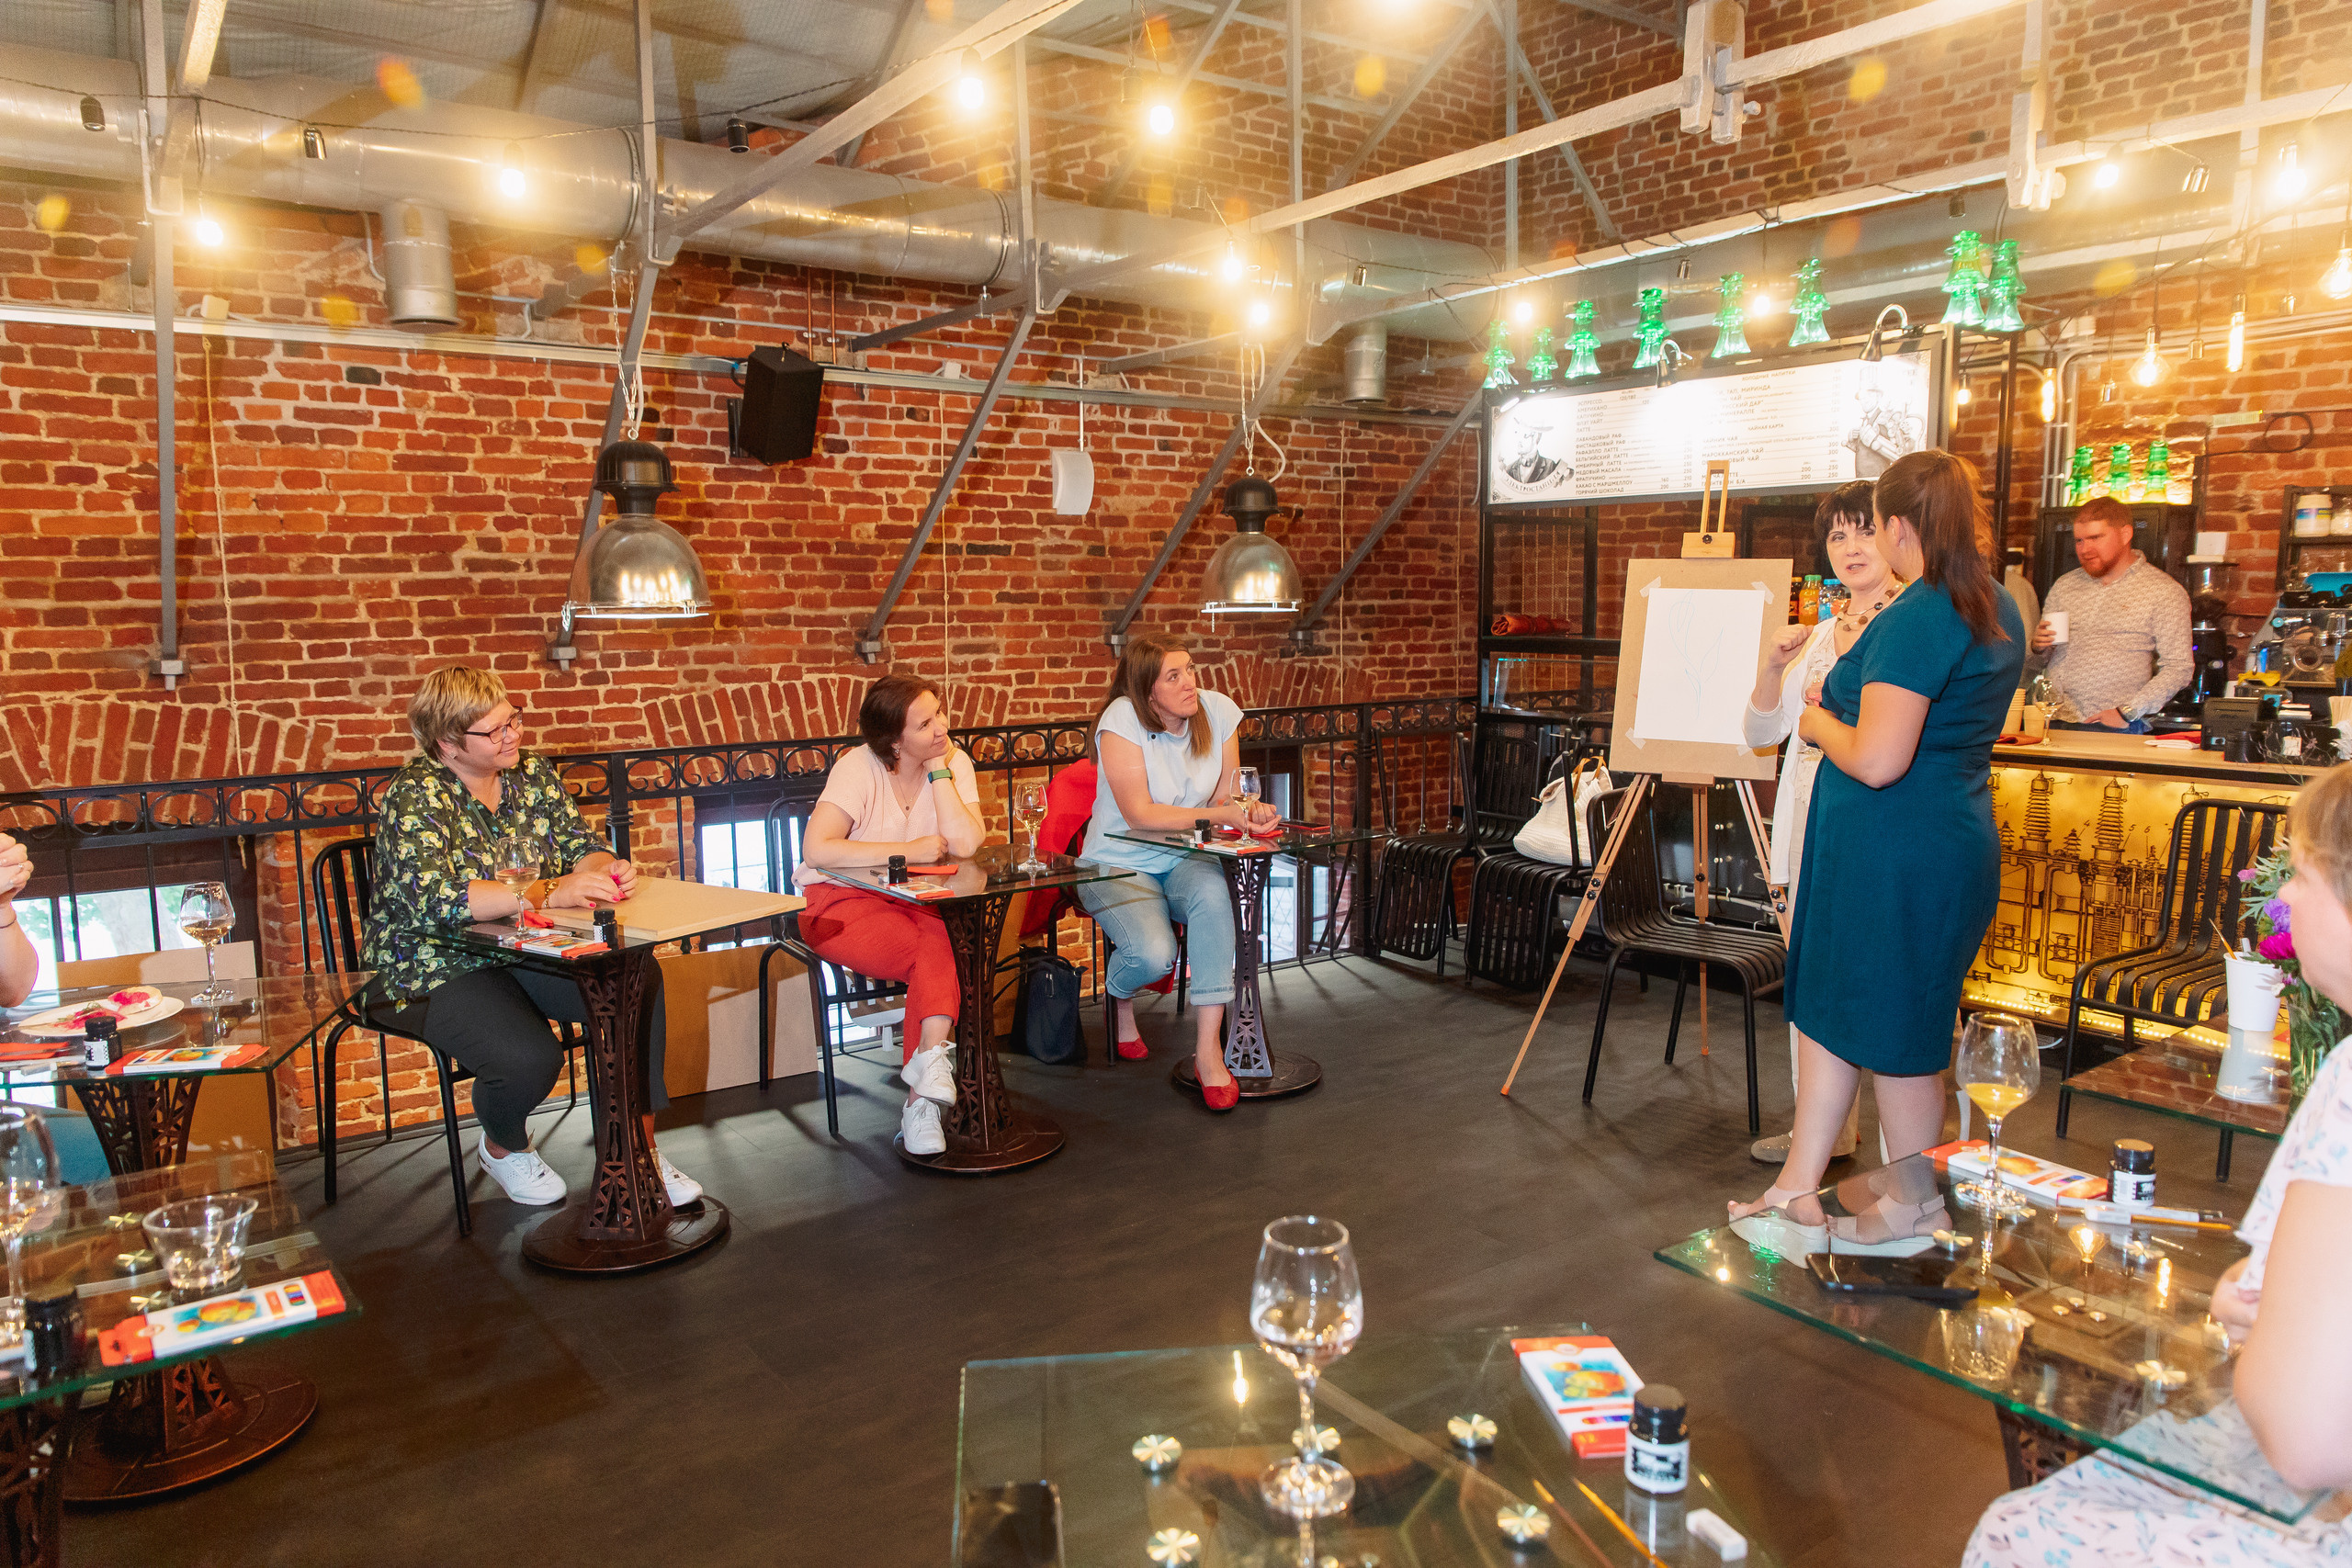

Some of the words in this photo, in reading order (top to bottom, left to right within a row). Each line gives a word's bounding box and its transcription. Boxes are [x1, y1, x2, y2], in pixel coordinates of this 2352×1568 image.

[1741, 385, 1771, 393] МИРИНДА
[1576, 434, 1610, 442] ЛАВАНДОВЫЙ
[1576, 440, 1614, 449] ФИСТАШКОВЫЙ
[1702, 449, 1749, 457] МАРОККАНСКИЙ
[1576, 455, 1611, 463] БЕЛЬГИЙСКИЙ
[2129, 824, 2137, 832] 5
[2143, 826, 2152, 834] 6
